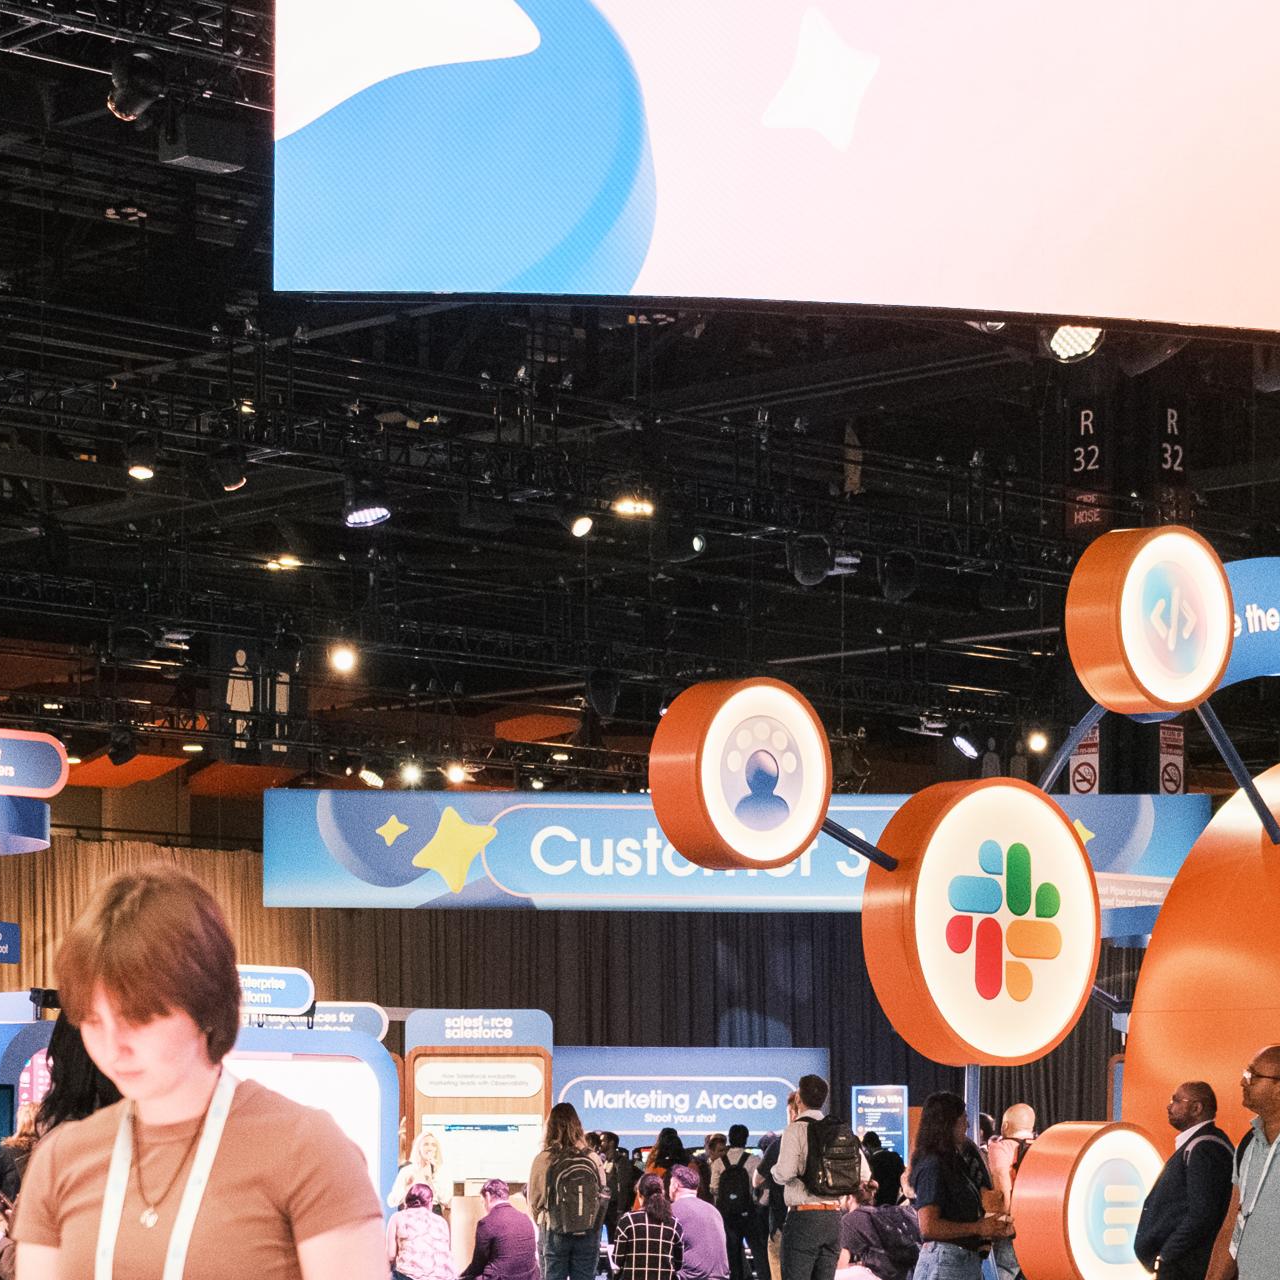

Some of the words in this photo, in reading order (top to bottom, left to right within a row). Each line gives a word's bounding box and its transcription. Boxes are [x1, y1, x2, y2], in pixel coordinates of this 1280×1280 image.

[1081, 410, 1094, 436] R
[1167, 409, 1179, 435] R
[1073, 445, 1100, 472] 32
[1161, 443, 1184, 472] 32
[1245, 603, 1280, 633] the
[530, 825, 818, 878] Custor
[444, 1026, 513, 1039] salesforce
[584, 1089, 690, 1113] Marketing
[696, 1089, 777, 1110] Arcade
[858, 1095, 876, 1105] Play
[876, 1095, 886, 1104] to
[886, 1095, 903, 1104] Win
[644, 1112, 671, 1124] Shoot
[673, 1114, 695, 1126] your
[696, 1112, 717, 1123] shot
